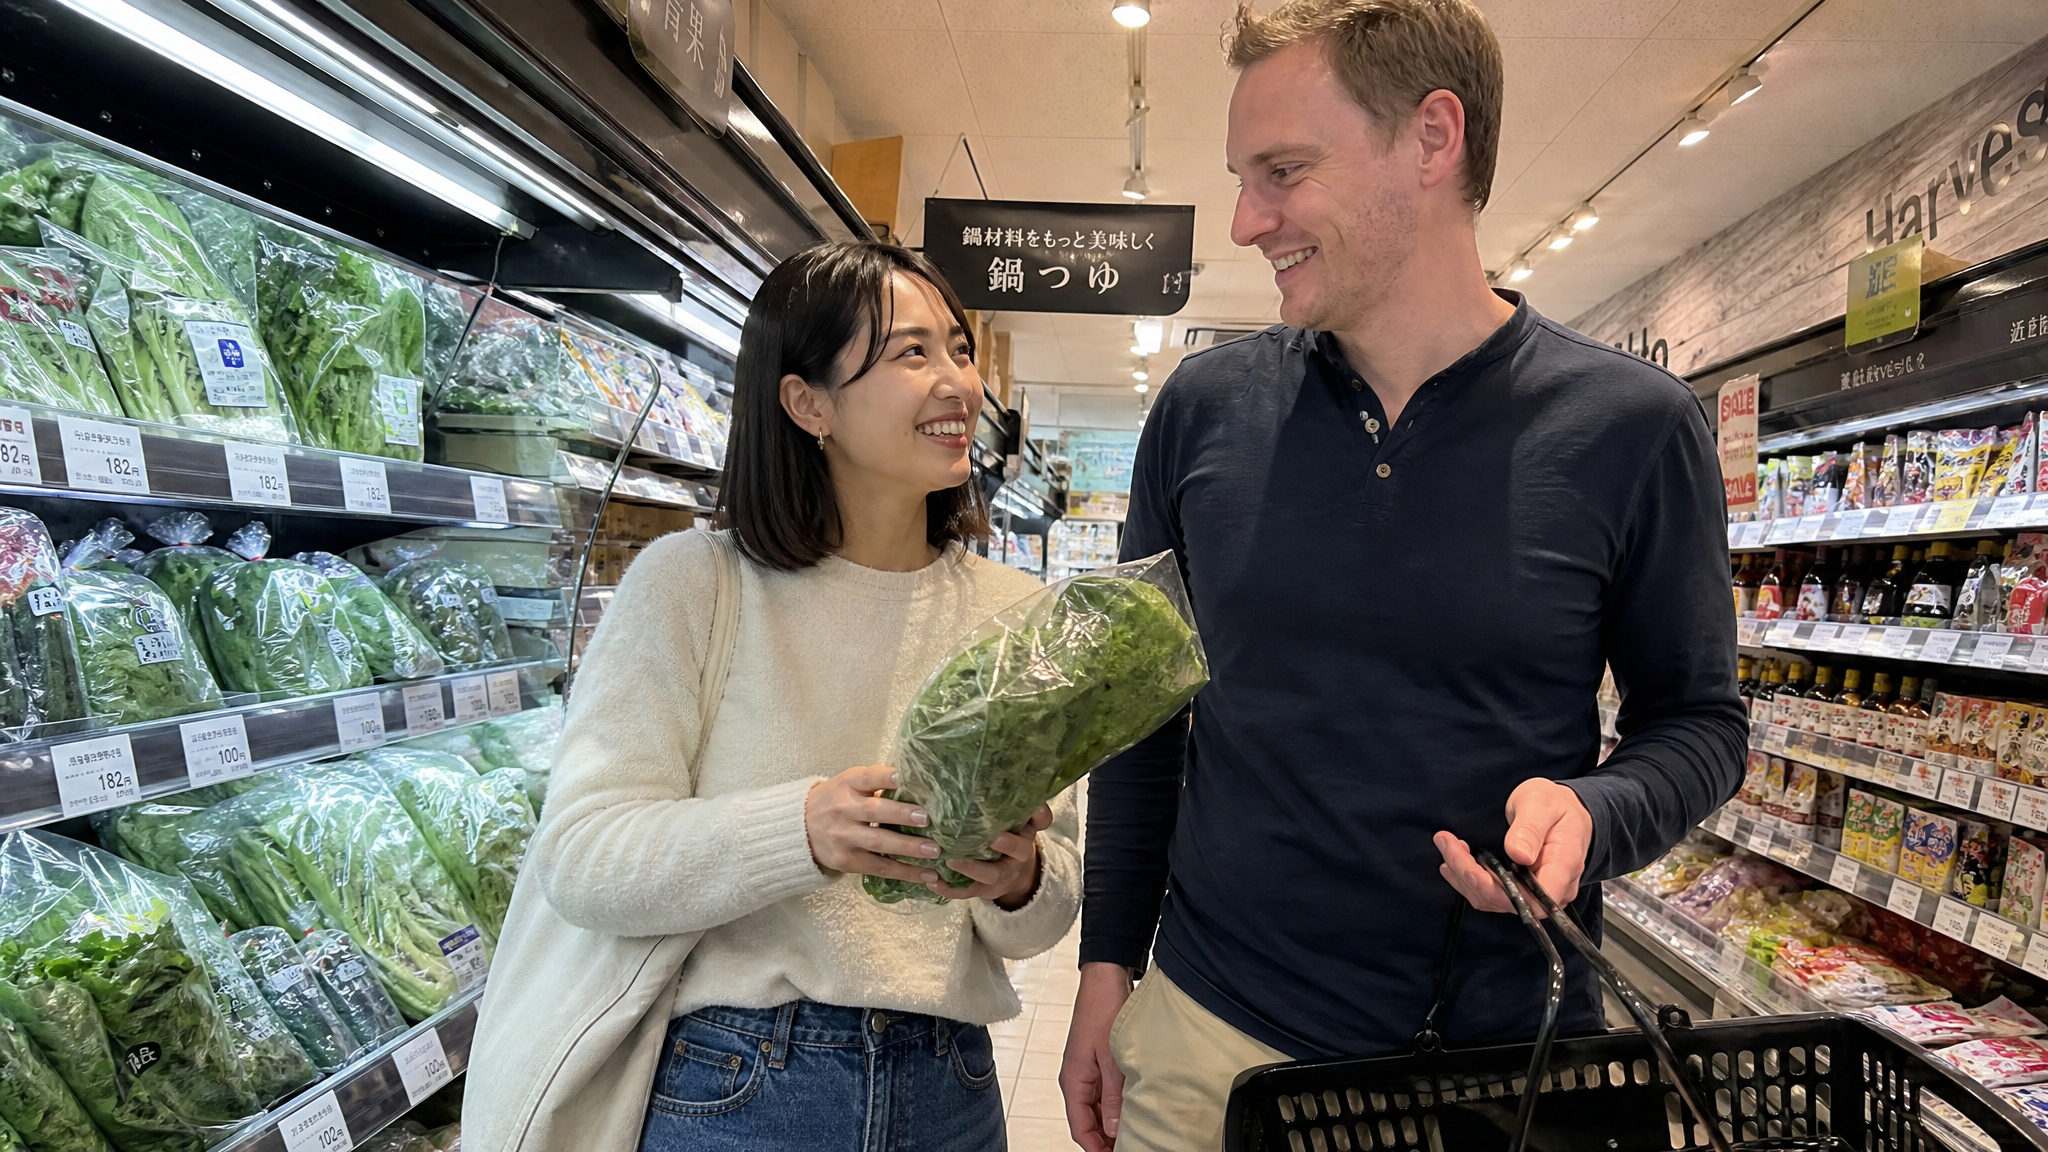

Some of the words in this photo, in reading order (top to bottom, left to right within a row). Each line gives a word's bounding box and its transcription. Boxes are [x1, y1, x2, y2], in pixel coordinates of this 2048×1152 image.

[962, 226, 1155, 250] 鍋材料をもっと美味しく
[987, 256, 1120, 295] 鍋つゆ
